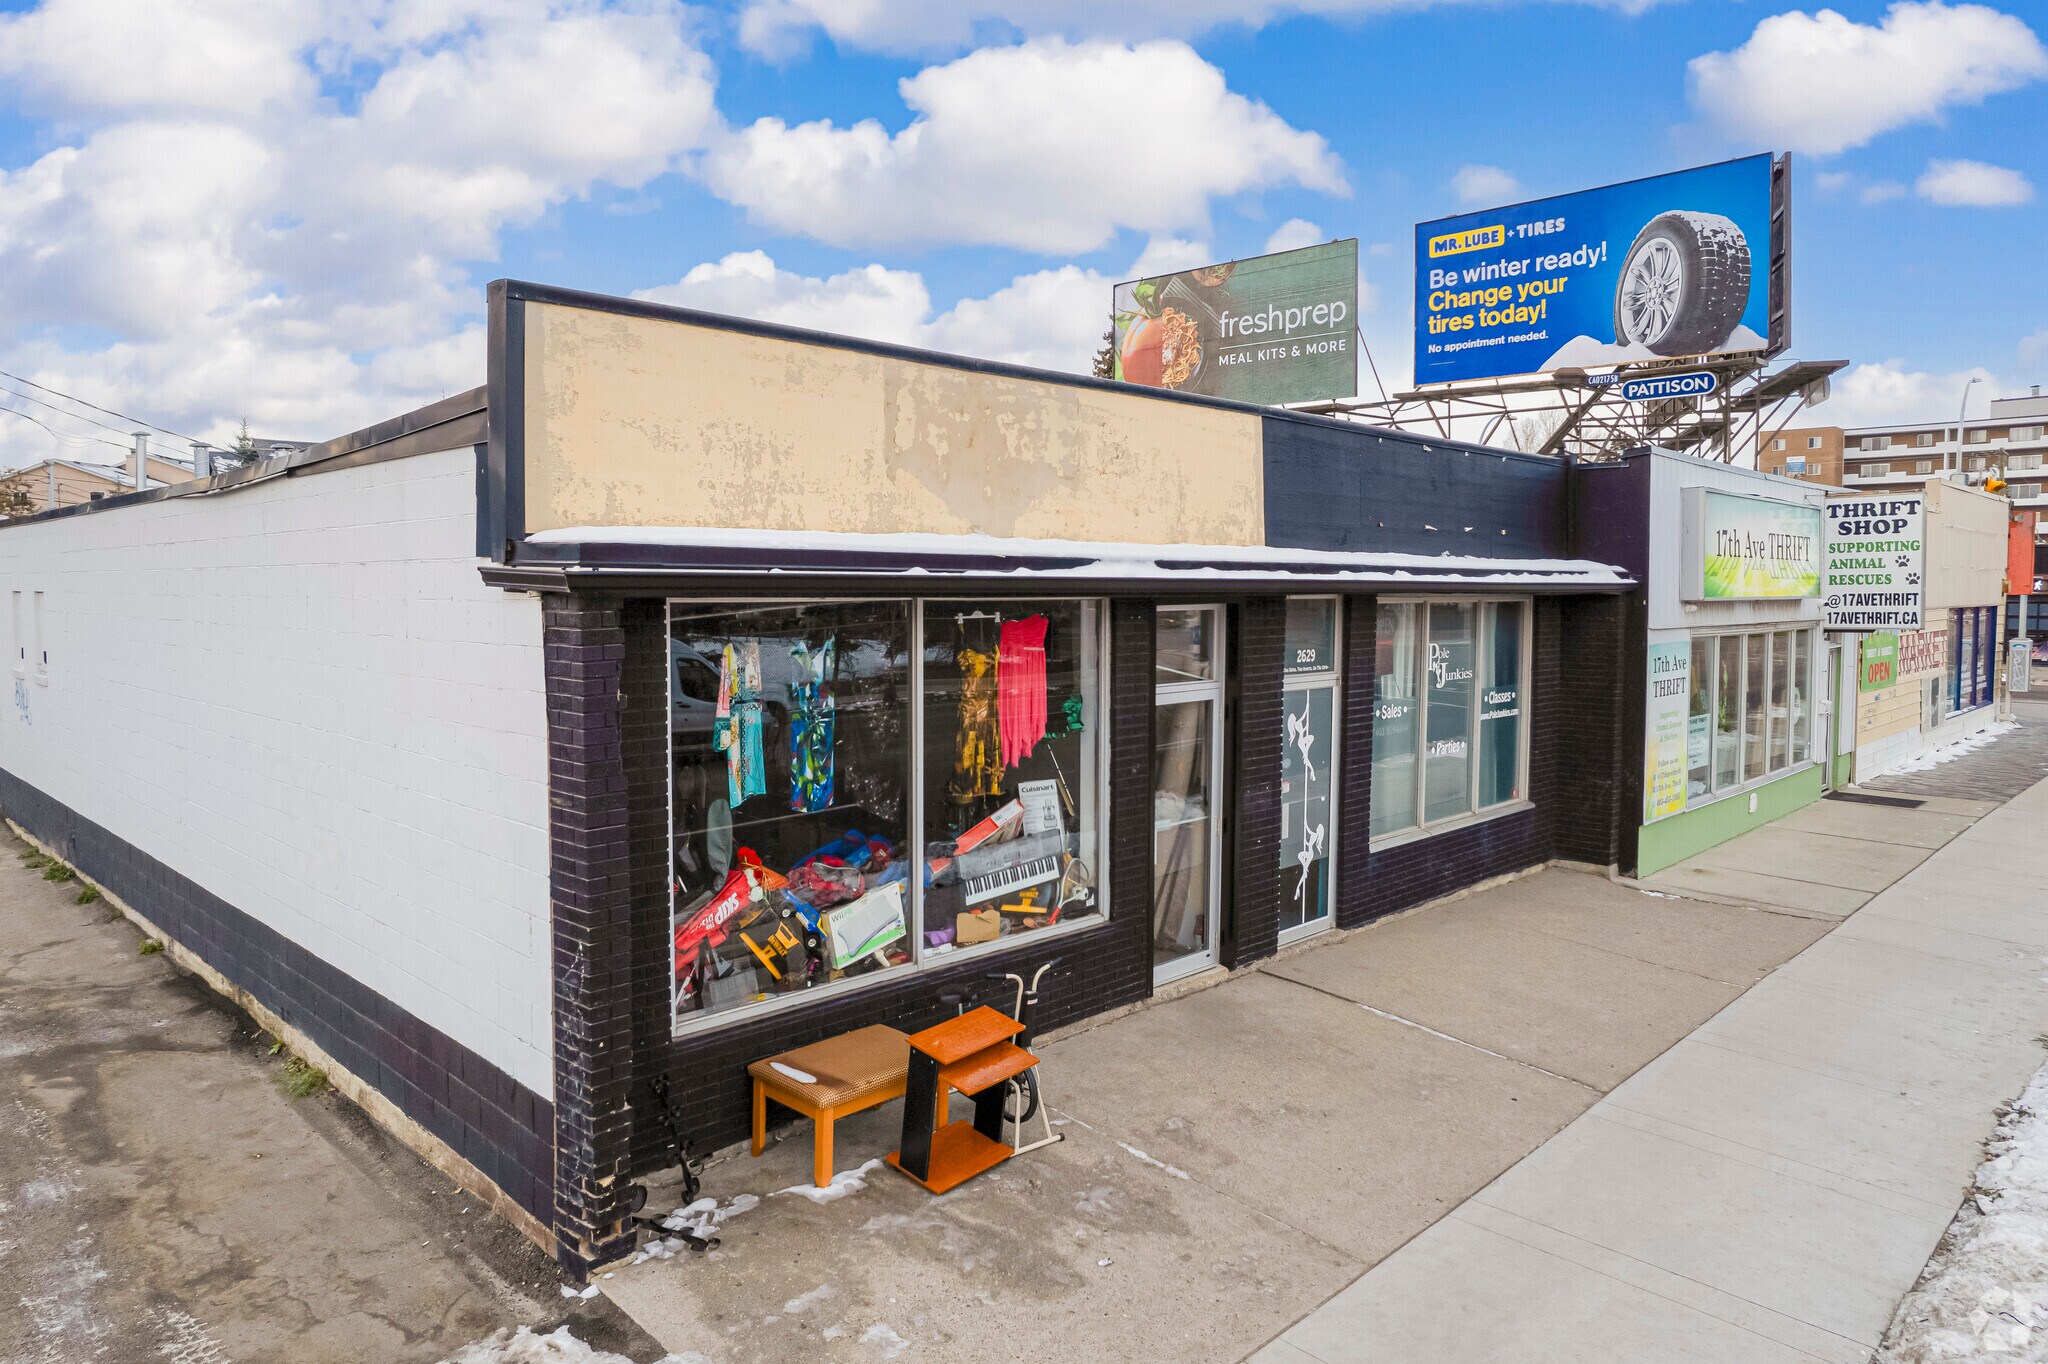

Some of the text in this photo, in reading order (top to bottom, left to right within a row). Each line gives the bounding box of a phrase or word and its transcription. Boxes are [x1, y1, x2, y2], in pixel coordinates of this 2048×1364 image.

[1434, 237, 1462, 253] MR.
[1464, 229, 1499, 249] LUBE
[1516, 217, 1566, 239] TIRES
[1430, 241, 1607, 289] Be winter ready!
[1428, 276, 1568, 312] Change your
[1219, 301, 1347, 338] freshprep
[1428, 299, 1547, 335] tires today!
[1428, 330, 1549, 354] No appointment needed.
[1218, 339, 1346, 366] MEAL KITS & MORE
[1628, 377, 1709, 397] PATTISON
[1826, 500, 1921, 519] THRIFT
[1838, 519, 1908, 536] SHOP
[1716, 529, 1811, 561] 17th Ave THRIFT
[1828, 540, 1920, 554] SUPPORTING
[1828, 558, 1886, 569] ANIMAL
[1828, 573, 1892, 586] RESCUES
[1827, 592, 1919, 608] @17AVETHRIFT
[1827, 611, 1919, 625] 17AVETHRIFT.CA
[1297, 649, 1316, 663] 2629
[1428, 643, 1450, 671] Pole
[1653, 654, 1687, 674] 17th Ave
[1436, 662, 1473, 689] Junkies
[1867, 661, 1891, 684] OPEN
[1488, 691, 1511, 704] Classes
[1653, 677, 1686, 698] THRIFT
[1381, 704, 1402, 720] Sales
[1436, 741, 1460, 756] Parties
[1021, 784, 1054, 793] Cuisinart
[714, 892, 740, 925] SKIP
[831, 913, 844, 923] Wii
